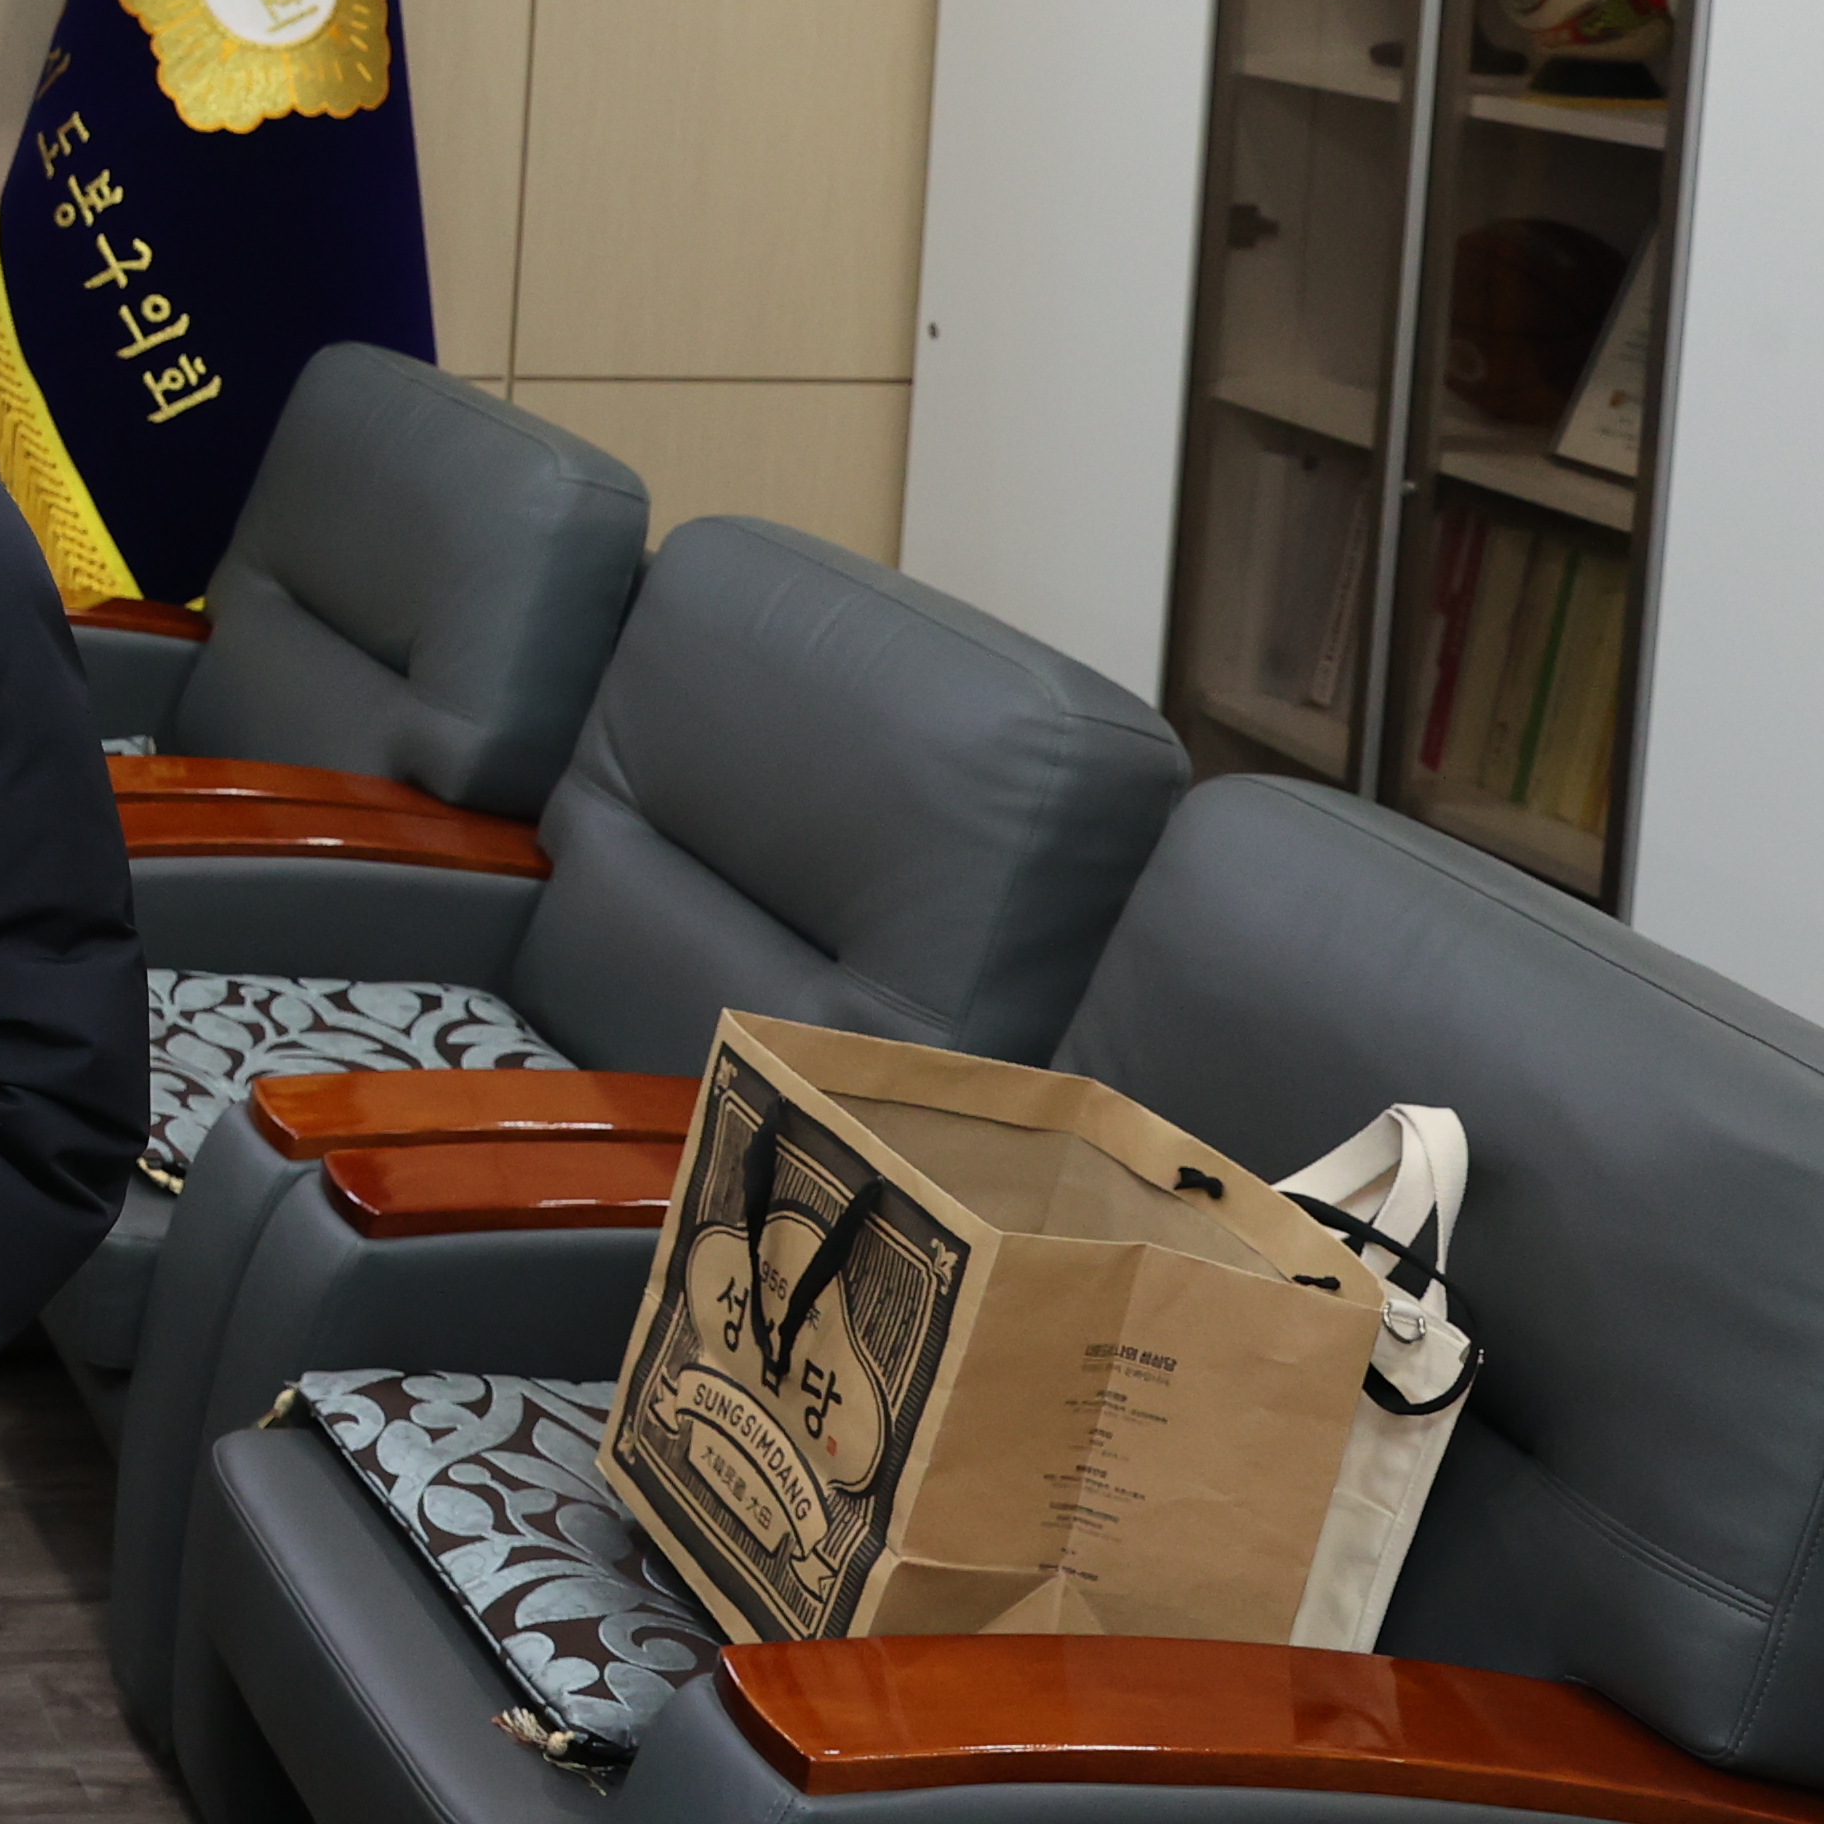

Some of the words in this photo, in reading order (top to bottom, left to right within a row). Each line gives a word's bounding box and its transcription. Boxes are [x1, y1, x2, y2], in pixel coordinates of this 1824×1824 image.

[36, 110, 222, 425] 도봉구의회
[759, 1261, 788, 1301] 956
[693, 1384, 812, 1522] SUNGSIMDANG
